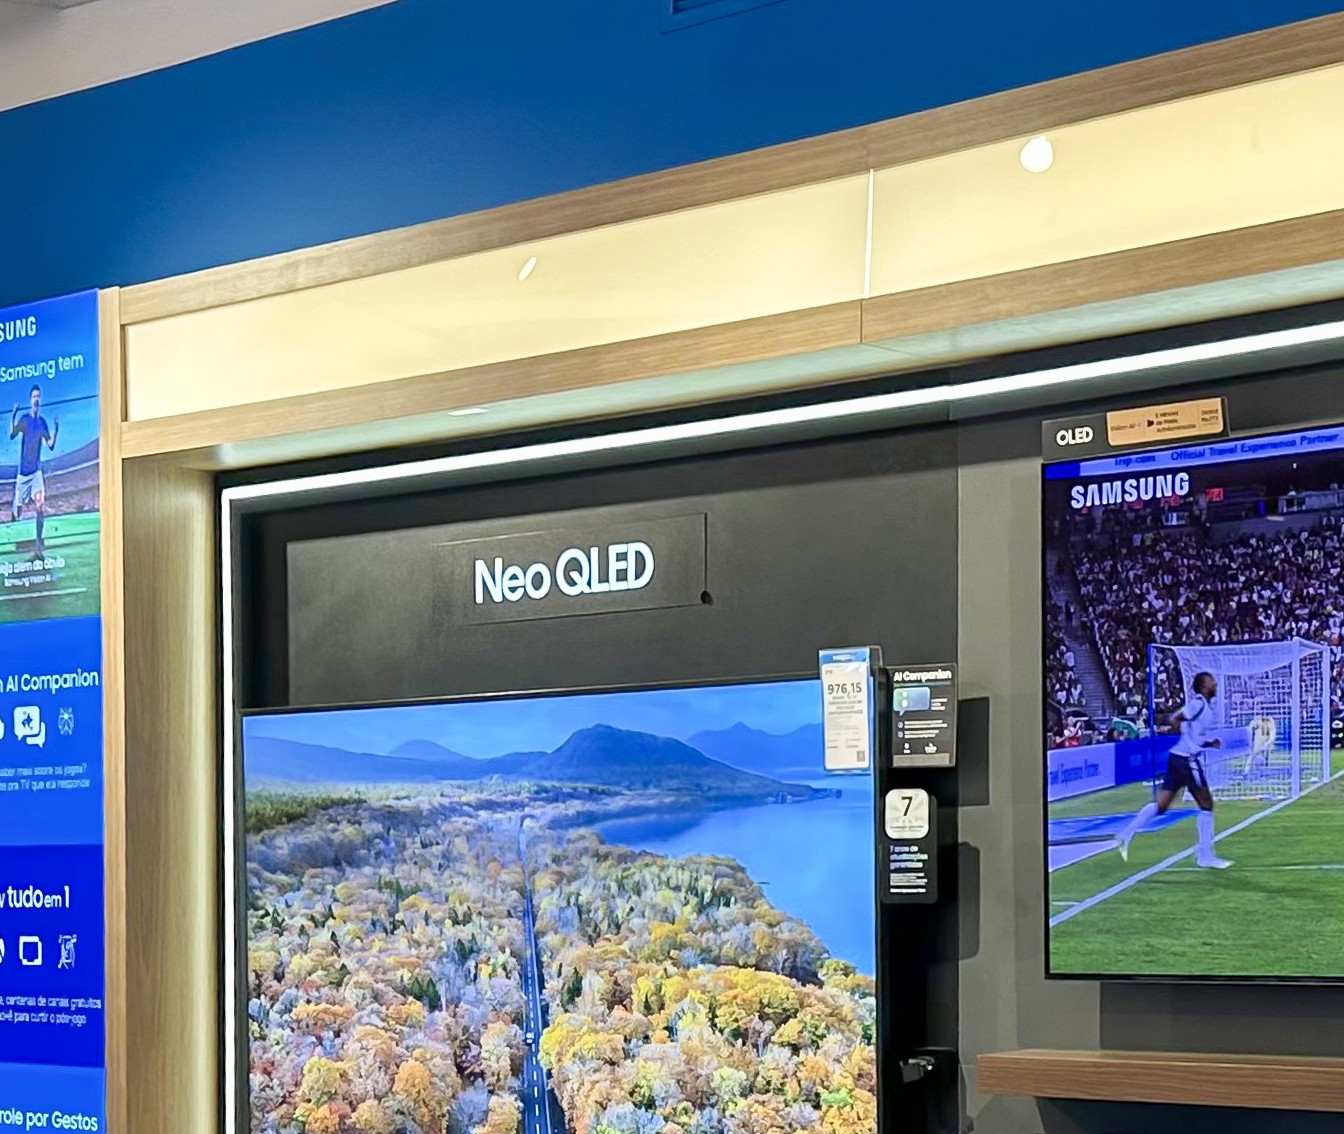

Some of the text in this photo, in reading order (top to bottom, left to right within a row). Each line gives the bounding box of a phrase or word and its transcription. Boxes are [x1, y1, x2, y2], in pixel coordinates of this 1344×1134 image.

[0, 359, 56, 383] Samsung
[58, 353, 84, 372] tem
[1056, 426, 1093, 446] OLED
[1071, 473, 1190, 509] SAMSUNG
[474, 541, 655, 604] Neo QLED
[6, 675, 18, 692] AI
[20, 668, 99, 694] Companion
[894, 669, 952, 683] AI Companion
[901, 796, 913, 816] 7
[7, 885, 43, 908] tudo
[44, 895, 62, 908] em
[64, 885, 70, 908] 1
[26, 1111, 48, 1131] por
[51, 1110, 98, 1132] Gestos
